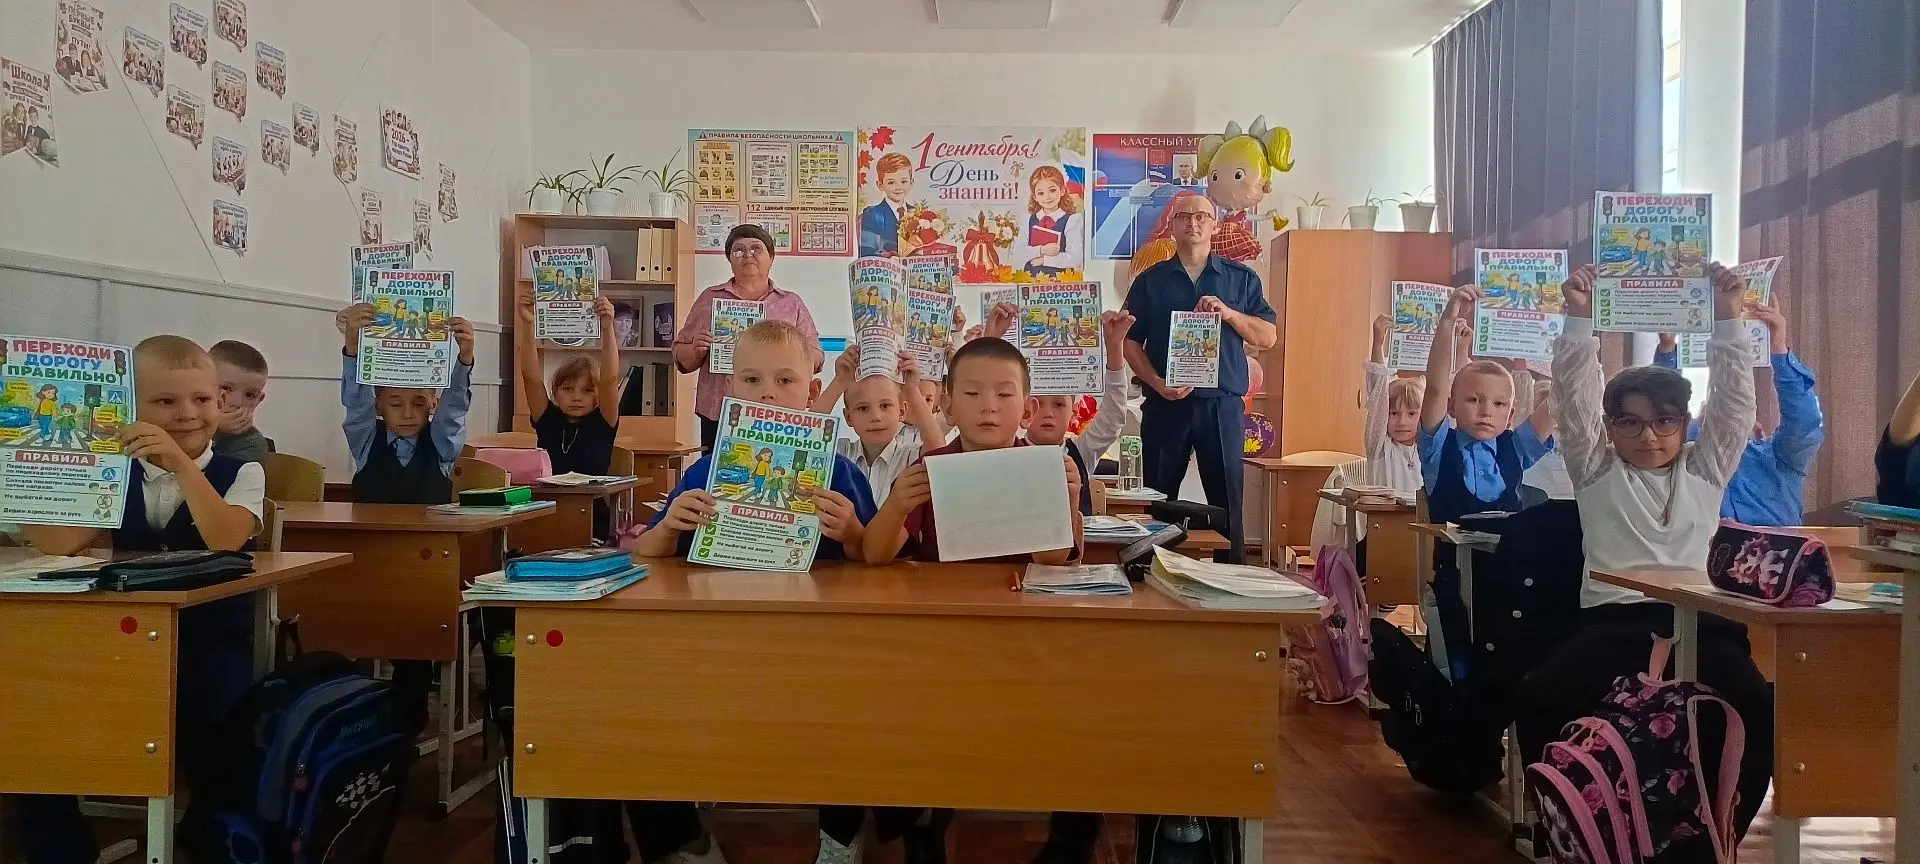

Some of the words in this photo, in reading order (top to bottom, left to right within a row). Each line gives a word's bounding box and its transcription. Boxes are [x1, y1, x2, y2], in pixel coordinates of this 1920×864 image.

[1120, 136, 1183, 146] КЛАССНЫЙ
[911, 132, 934, 172] 1
[936, 135, 1041, 164] сентября!
[930, 160, 999, 188] День
[939, 182, 1019, 200] знаний!
[1616, 196, 1693, 206] ПЕРЕХОДИ
[1624, 206, 1684, 215] ДОРОГУ
[1612, 216, 1696, 224] ПРАВИЛЬНО
[363, 245, 405, 254] ПЕРЕХОДИ
[541, 248, 586, 256] ПЕРЕХОДИ
[361, 257, 406, 265] ПРАВИЛЬНО
[856, 260, 900, 273] ПЕРЕХОДИ
[381, 272, 441, 282] ПЕРЕХОДИ
[861, 268, 897, 278] ДОРОГУ
[388, 280, 434, 288] ДОРОГУ
[1032, 284, 1088, 292] ПЕРЕХОДИ
[1405, 284, 1446, 292] ПЕРЕХОДИ
[1626, 280, 1679, 288] ПРАВИЛА
[378, 288, 443, 296] ПРАВИЛЬНО
[910, 298, 940, 307] ДОРОГУ
[909, 303, 945, 314] АВИЛЬНО
[1502, 312, 1540, 320] ПРАВИЛА
[13, 340, 111, 360] ПЕРЕХОДИ
[24, 354, 102, 370] ДОРОГУ
[8, 365, 116, 384] ПРАВИЛЬНО
[746, 406, 822, 428] ПЕРЕХОДИ
[751, 420, 812, 438] ДОРОГУ
[737, 428, 821, 450] ПРАВИЛЬНО
[23, 452, 89, 464] ПРАВИЛА
[738, 508, 788, 522] ПРАВИЛА
